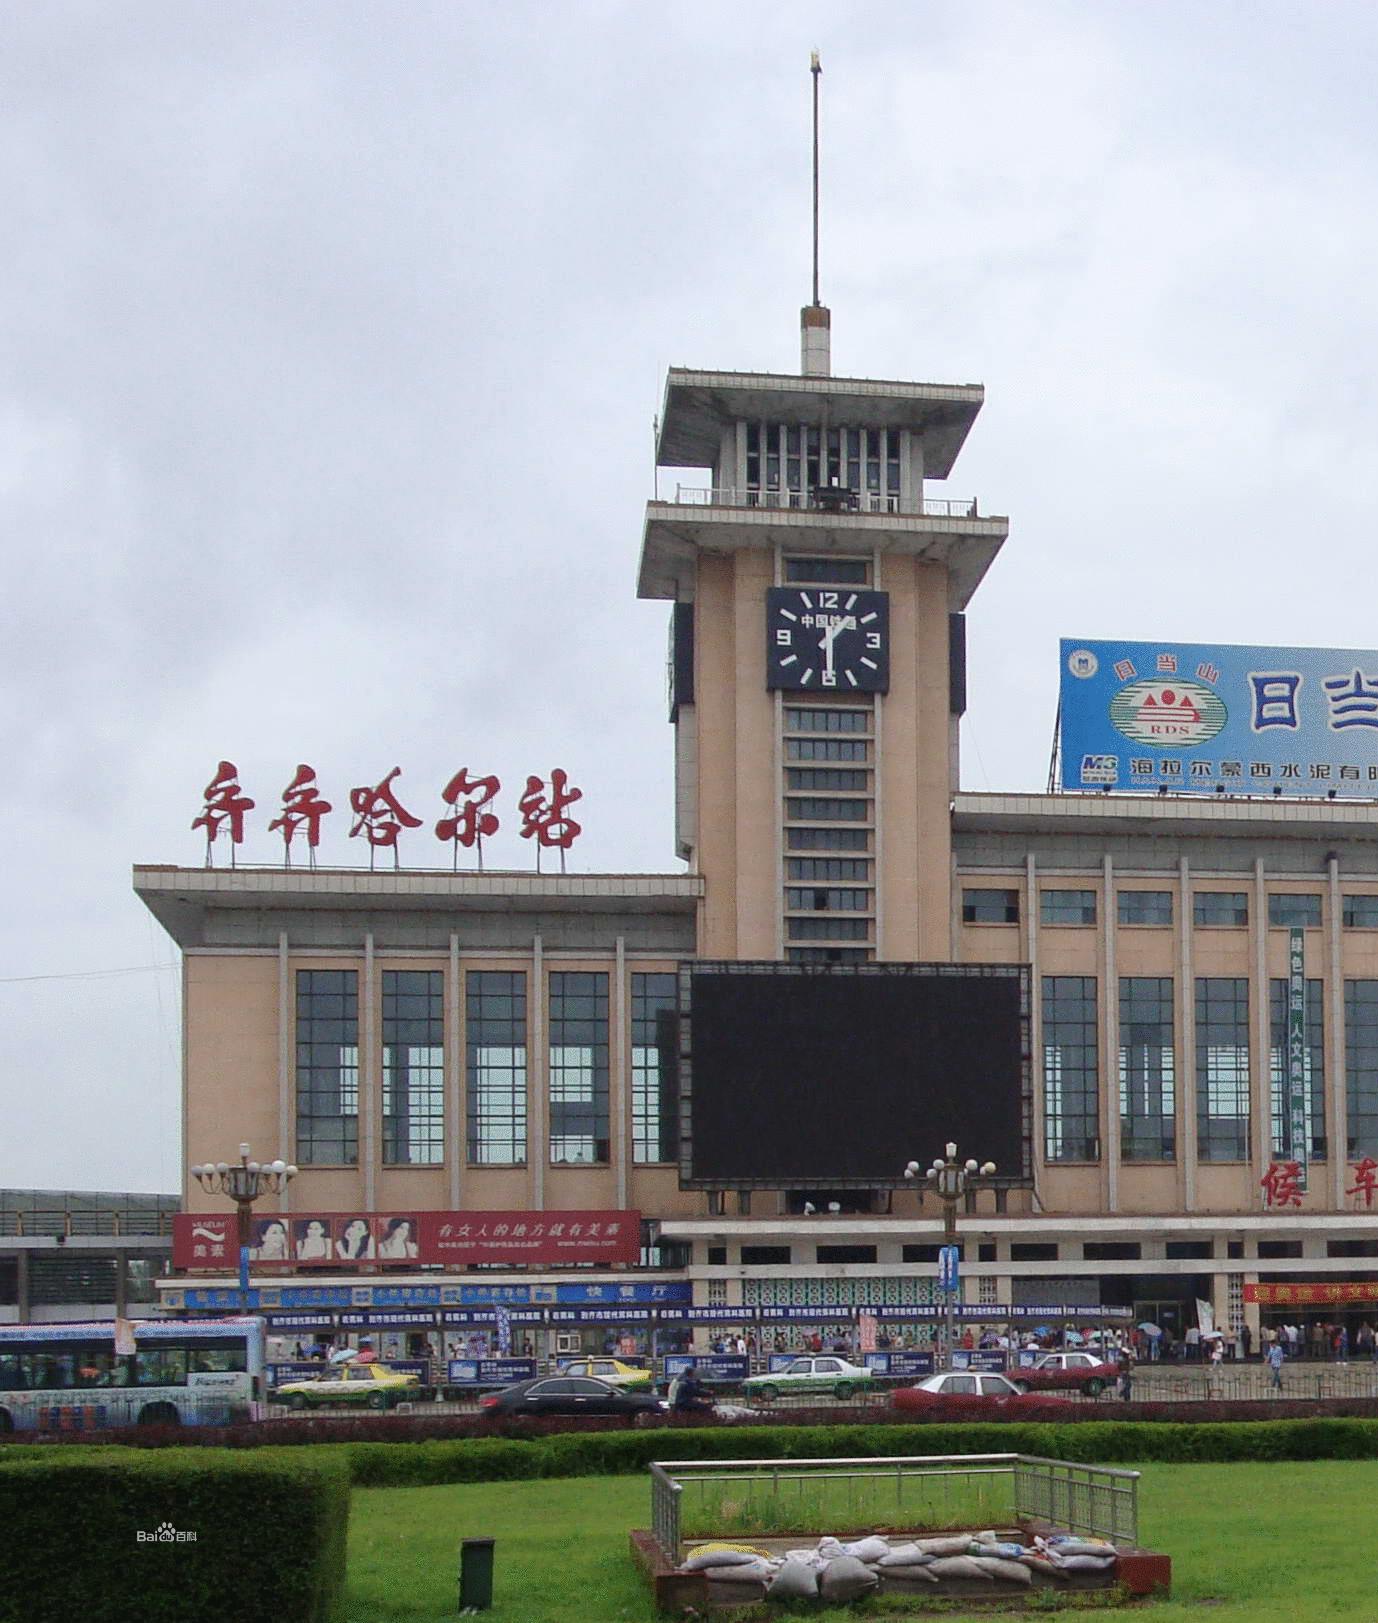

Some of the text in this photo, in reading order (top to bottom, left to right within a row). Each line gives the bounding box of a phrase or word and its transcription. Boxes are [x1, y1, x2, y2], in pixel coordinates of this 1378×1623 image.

[819, 591, 839, 608] 12
[801, 614, 857, 630] 中国
[776, 629, 792, 646] 9
[866, 632, 881, 648] 3
[1113, 653, 1220, 684] 日当山
[822, 670, 837, 686] 6
[1150, 725, 1190, 736] RDS
[191, 760, 584, 848] 齐齐哈尔站
